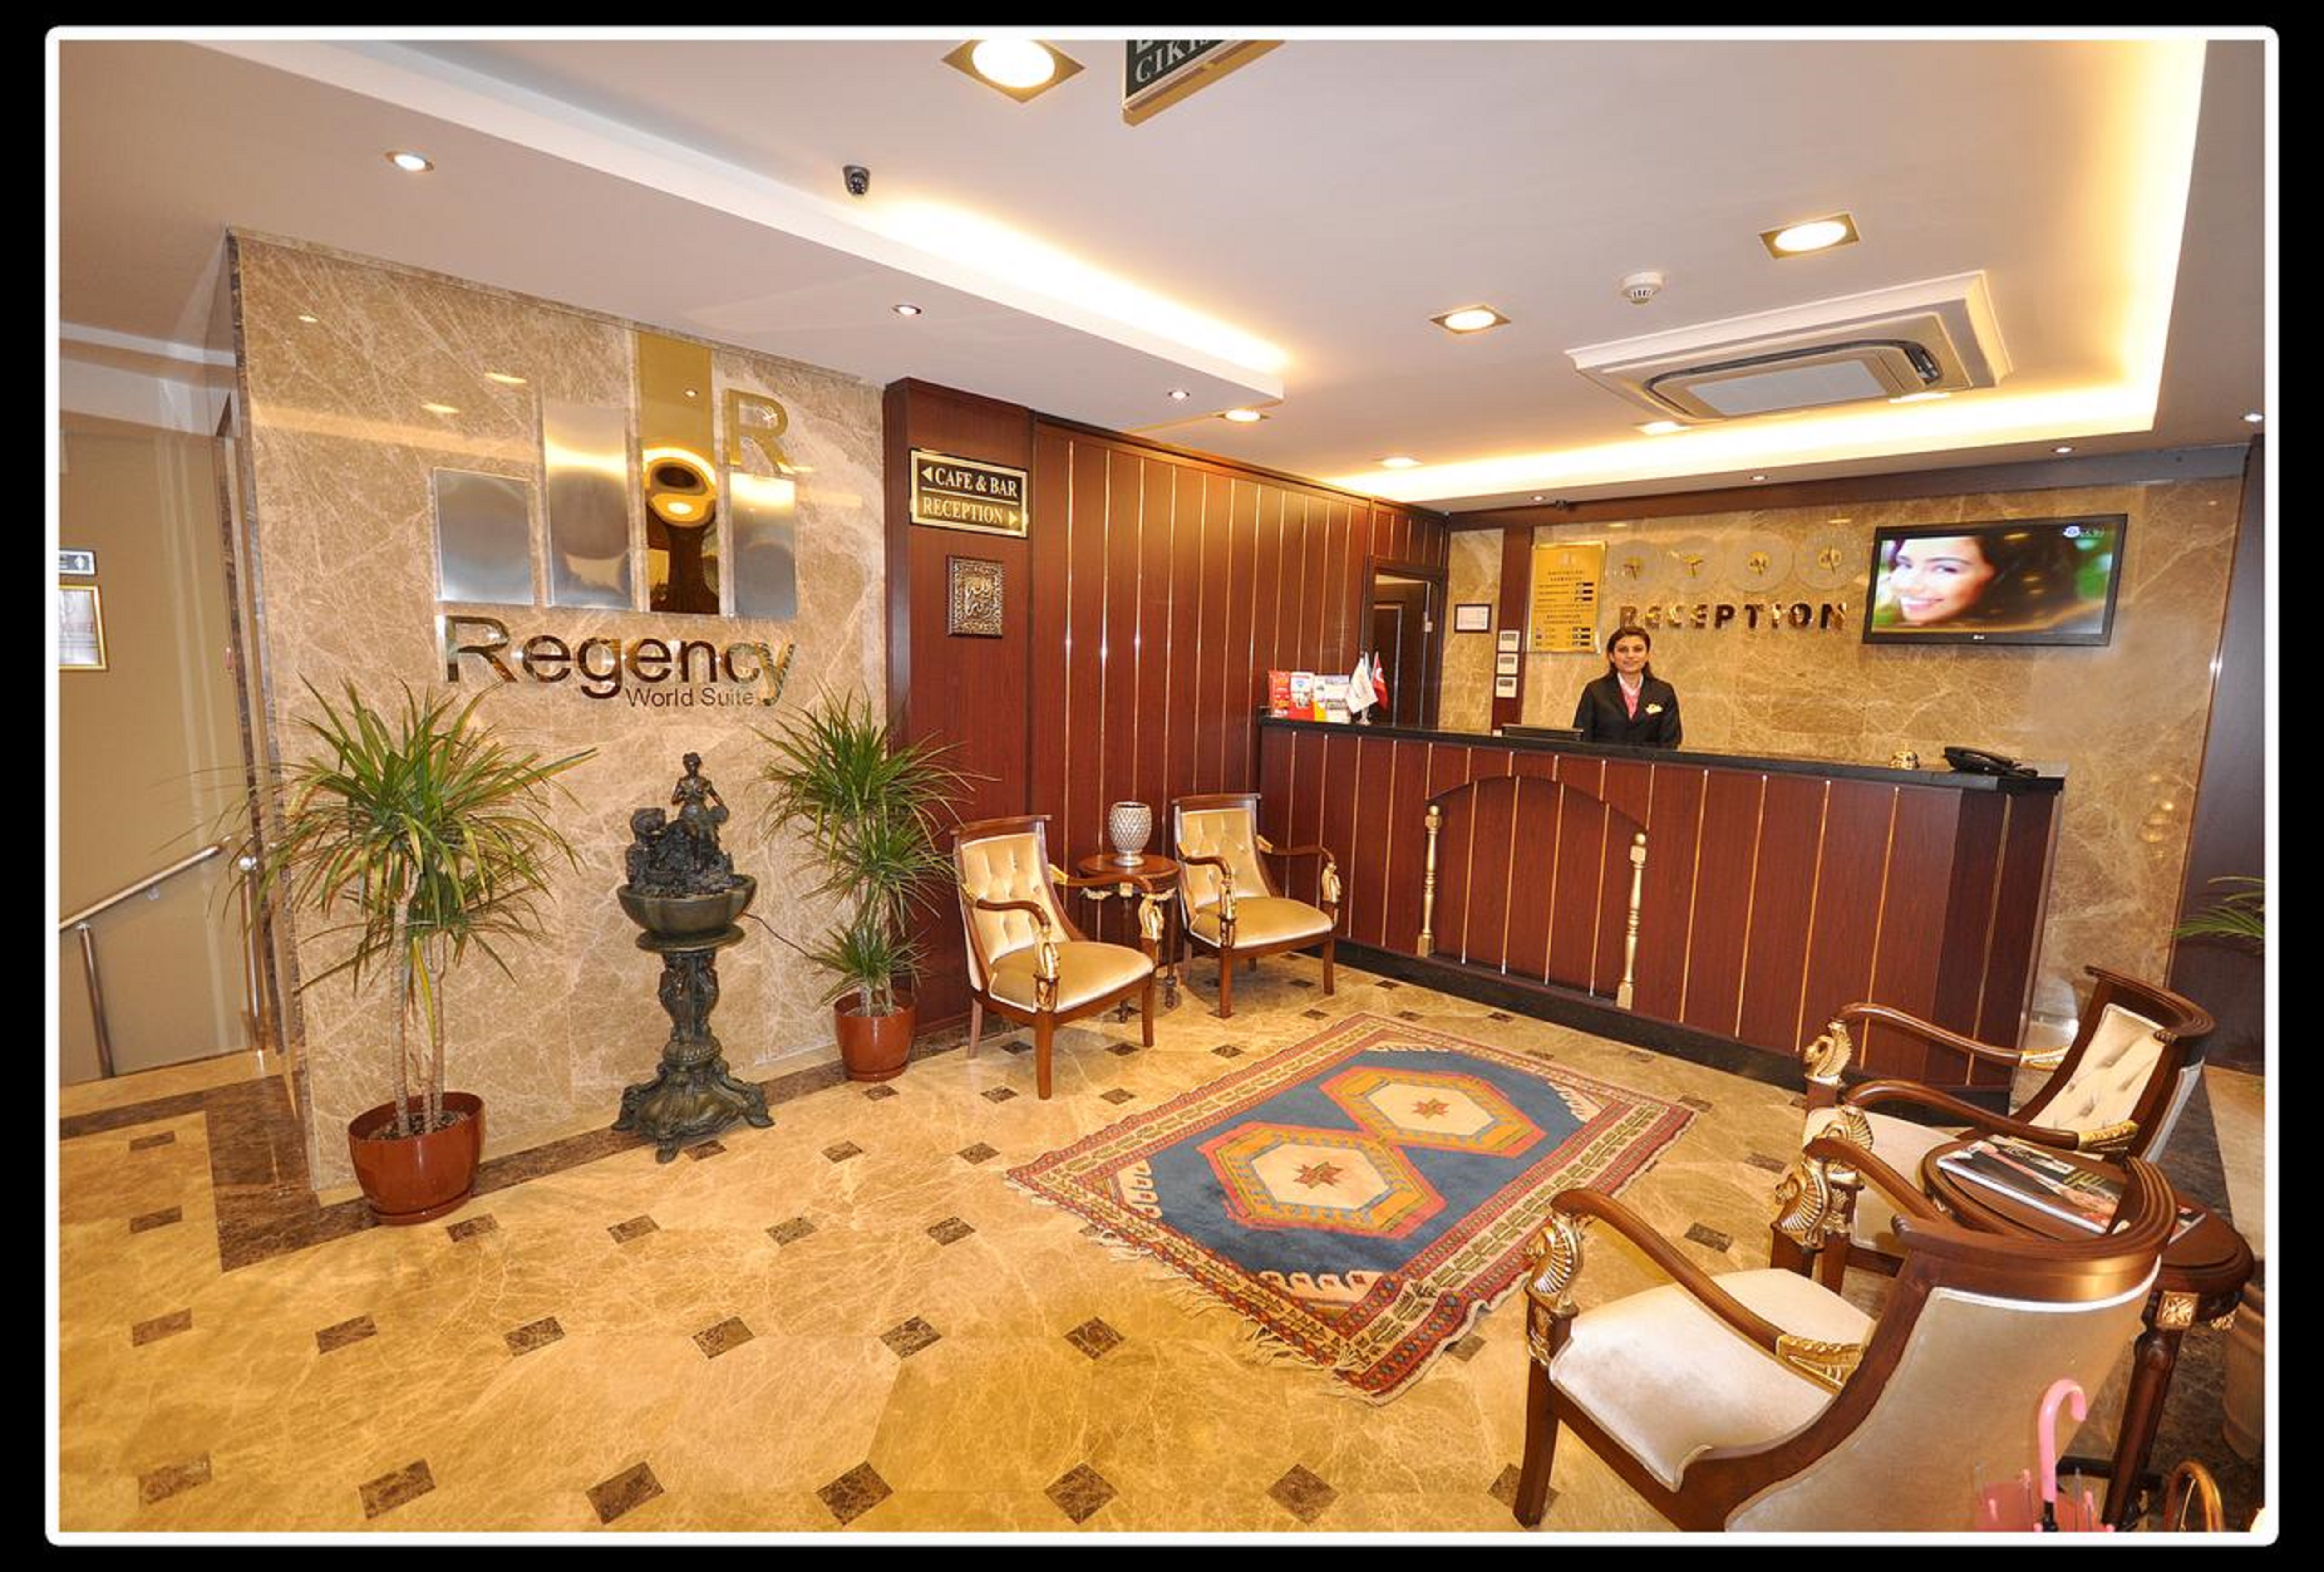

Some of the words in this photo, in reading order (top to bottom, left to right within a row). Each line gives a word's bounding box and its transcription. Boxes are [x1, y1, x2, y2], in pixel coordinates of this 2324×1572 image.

[722, 388, 789, 474] R
[936, 467, 973, 490] CAFE
[975, 475, 987, 492] &
[990, 477, 1017, 497] BAR
[923, 497, 1003, 524] RECEPTION
[1619, 602, 1847, 630] RECEPTION
[437, 615, 796, 706] Regency
[625, 688, 693, 707] World
[701, 688, 754, 707] Suite
